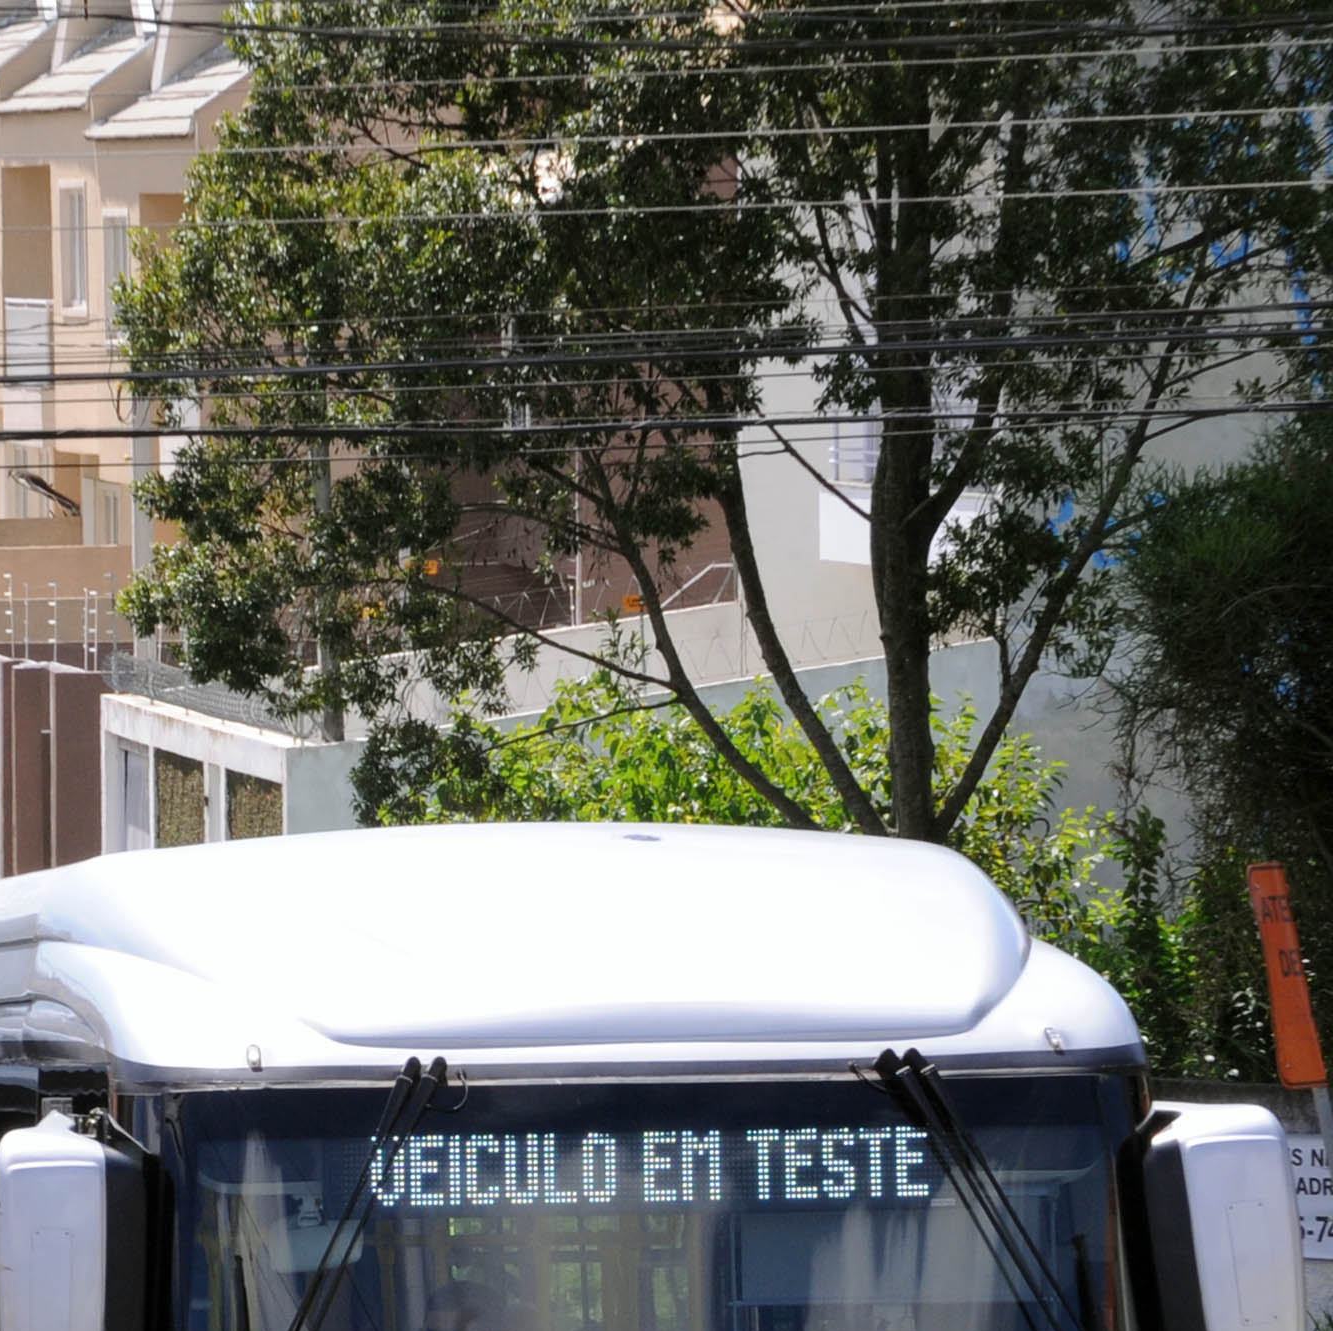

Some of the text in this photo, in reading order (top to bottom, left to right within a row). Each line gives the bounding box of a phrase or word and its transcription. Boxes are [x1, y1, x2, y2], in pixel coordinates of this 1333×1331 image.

[370, 1126, 930, 1206] VEICULO EM TESTE
[1287, 1147, 1330, 1167] S N
